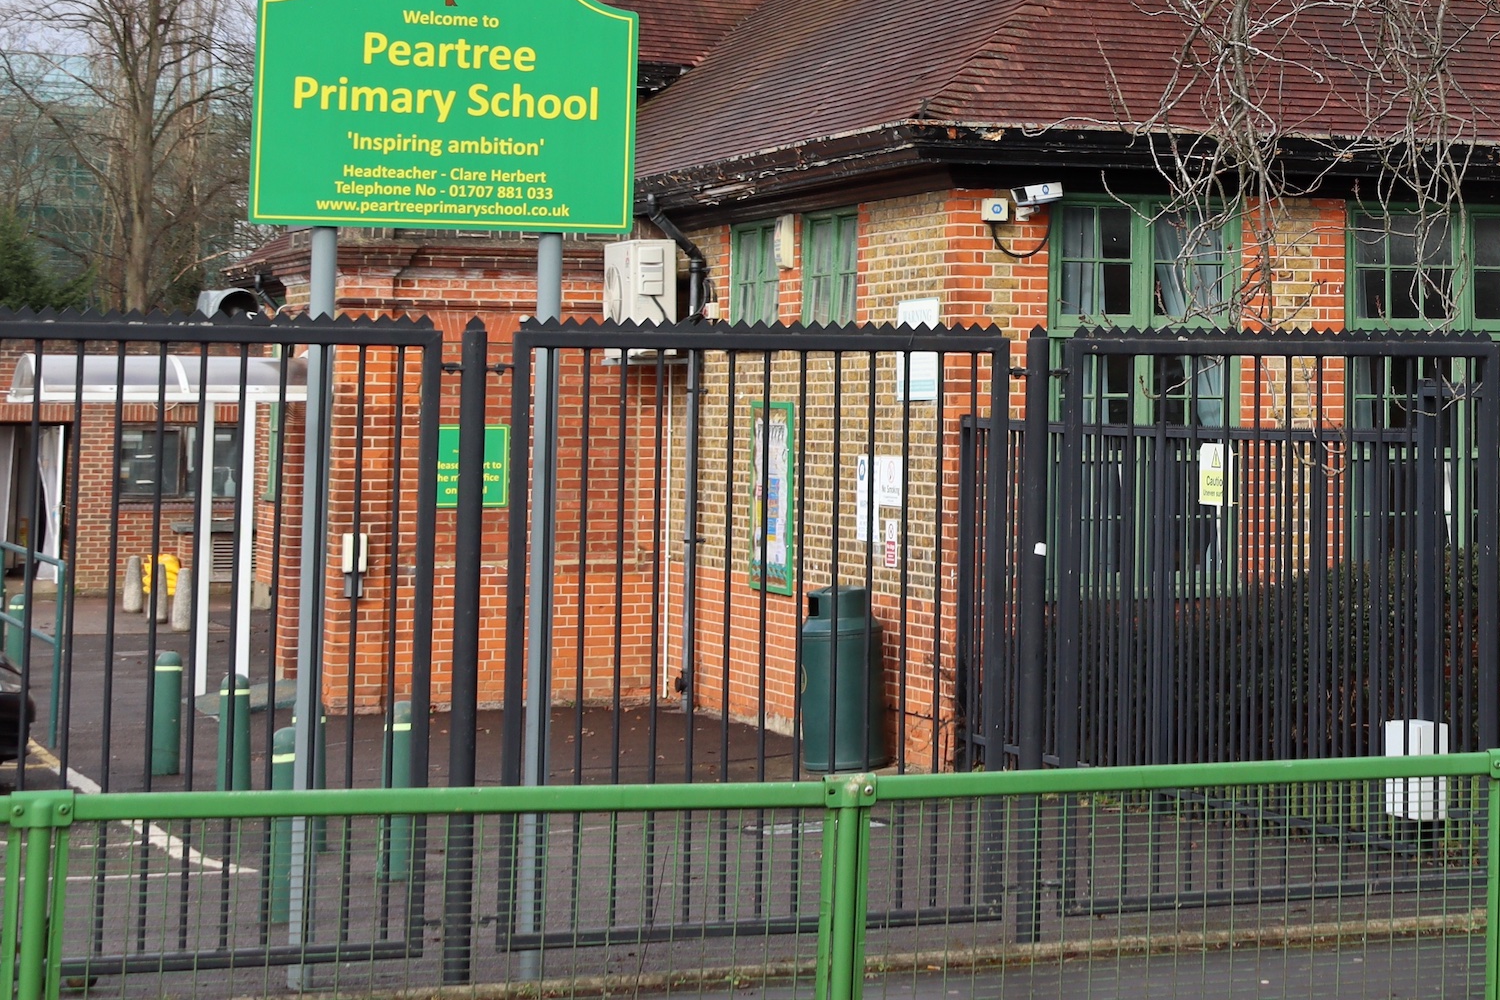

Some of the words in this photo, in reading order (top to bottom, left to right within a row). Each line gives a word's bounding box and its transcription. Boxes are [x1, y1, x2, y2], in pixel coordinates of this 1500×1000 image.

[402, 9, 479, 27] Welcome
[482, 14, 500, 28] to
[363, 31, 537, 72] Peartree
[293, 76, 457, 123] Primary
[467, 83, 599, 121] School
[347, 131, 443, 157] 'Inspiring
[447, 137, 545, 156] ambition'
[343, 164, 438, 180] Headteacher
[449, 167, 487, 182] Clare
[491, 169, 547, 184] Herbert
[334, 180, 412, 197] Telephone
[415, 183, 437, 197] No
[449, 184, 494, 198] 01707
[497, 185, 523, 199] 881
[526, 186, 554, 200] 033
[316, 200, 570, 217] www.peartreeprimaryschool.co.uk
[492, 461, 502, 469] to
[1206, 475, 1224, 487] Cautio
